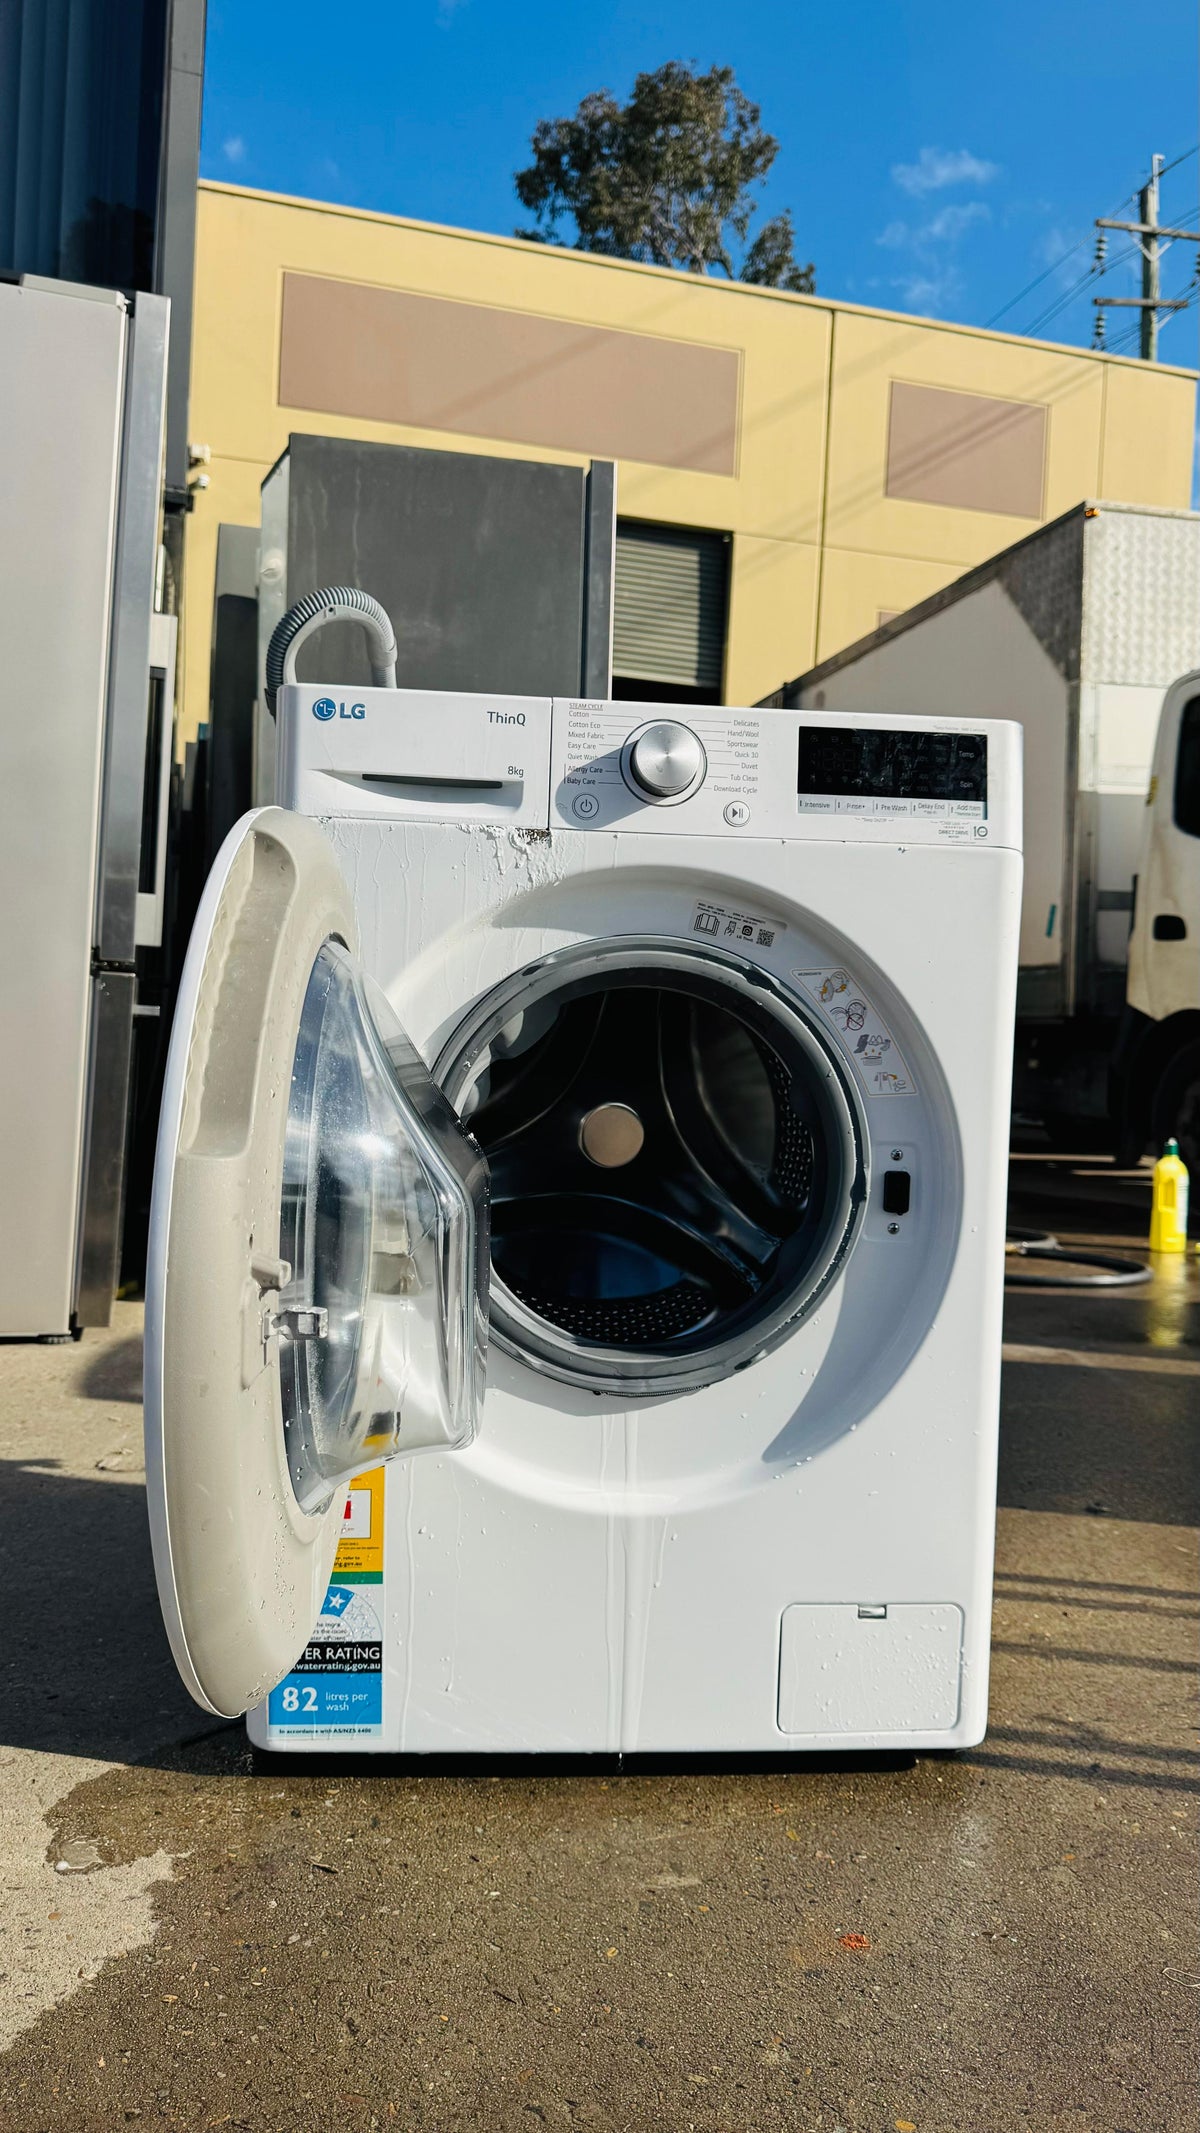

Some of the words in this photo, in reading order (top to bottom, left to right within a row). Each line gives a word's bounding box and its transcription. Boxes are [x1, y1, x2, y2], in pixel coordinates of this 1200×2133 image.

[339, 703, 365, 719] LG
[487, 711, 526, 726] ThinQ
[508, 766, 523, 778] 8kg
[568, 765, 588, 773] Allergy
[714, 785, 741, 793] Download
[743, 786, 757, 794] Cycle
[305, 1647, 322, 1660] ER
[326, 1647, 380, 1660] RATING
[294, 1661, 380, 1671] .waterrating.gov.au
[282, 1686, 319, 1712] 82
[325, 1692, 349, 1701] litres
[352, 1693, 368, 1703] per
[325, 1703, 349, 1711] wash
